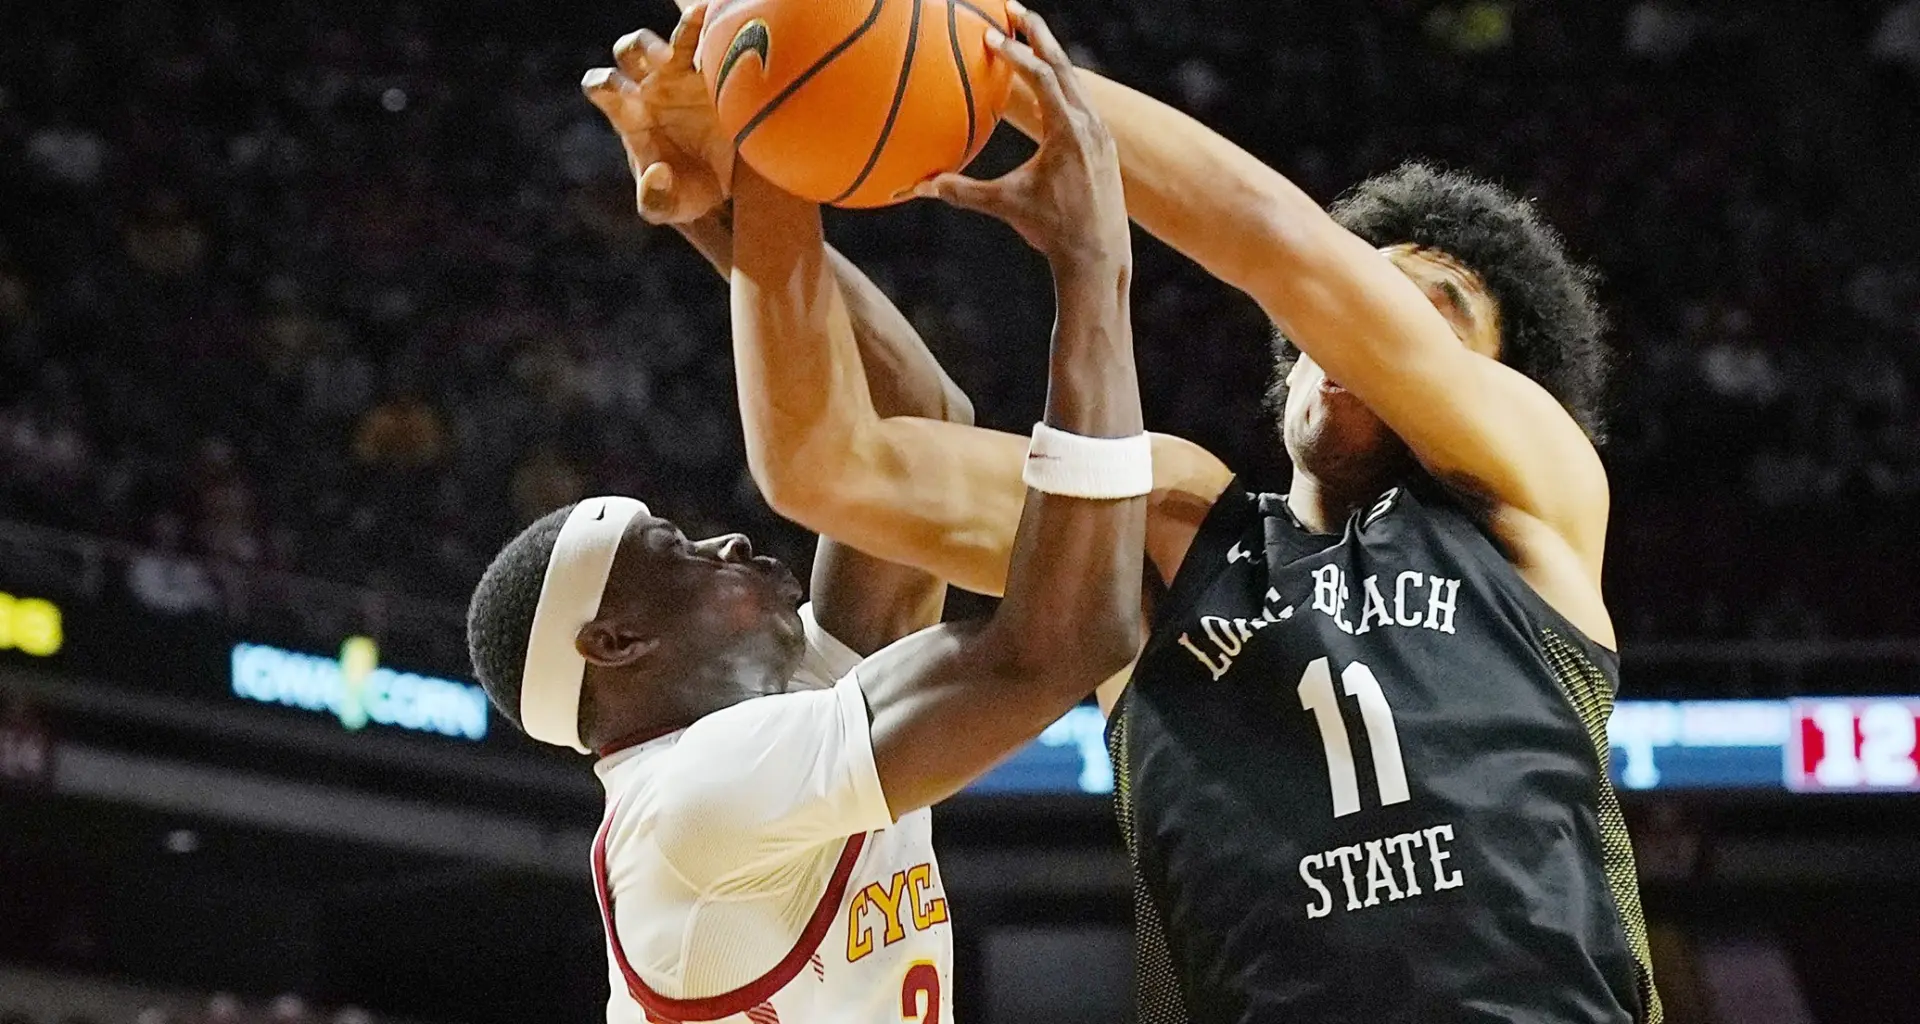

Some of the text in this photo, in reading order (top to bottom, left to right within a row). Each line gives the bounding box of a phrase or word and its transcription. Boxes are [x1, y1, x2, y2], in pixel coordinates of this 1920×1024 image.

[1311, 563, 1461, 636] BEACH
[1297, 656, 1411, 818] 11
[1299, 824, 1464, 919] STATE
